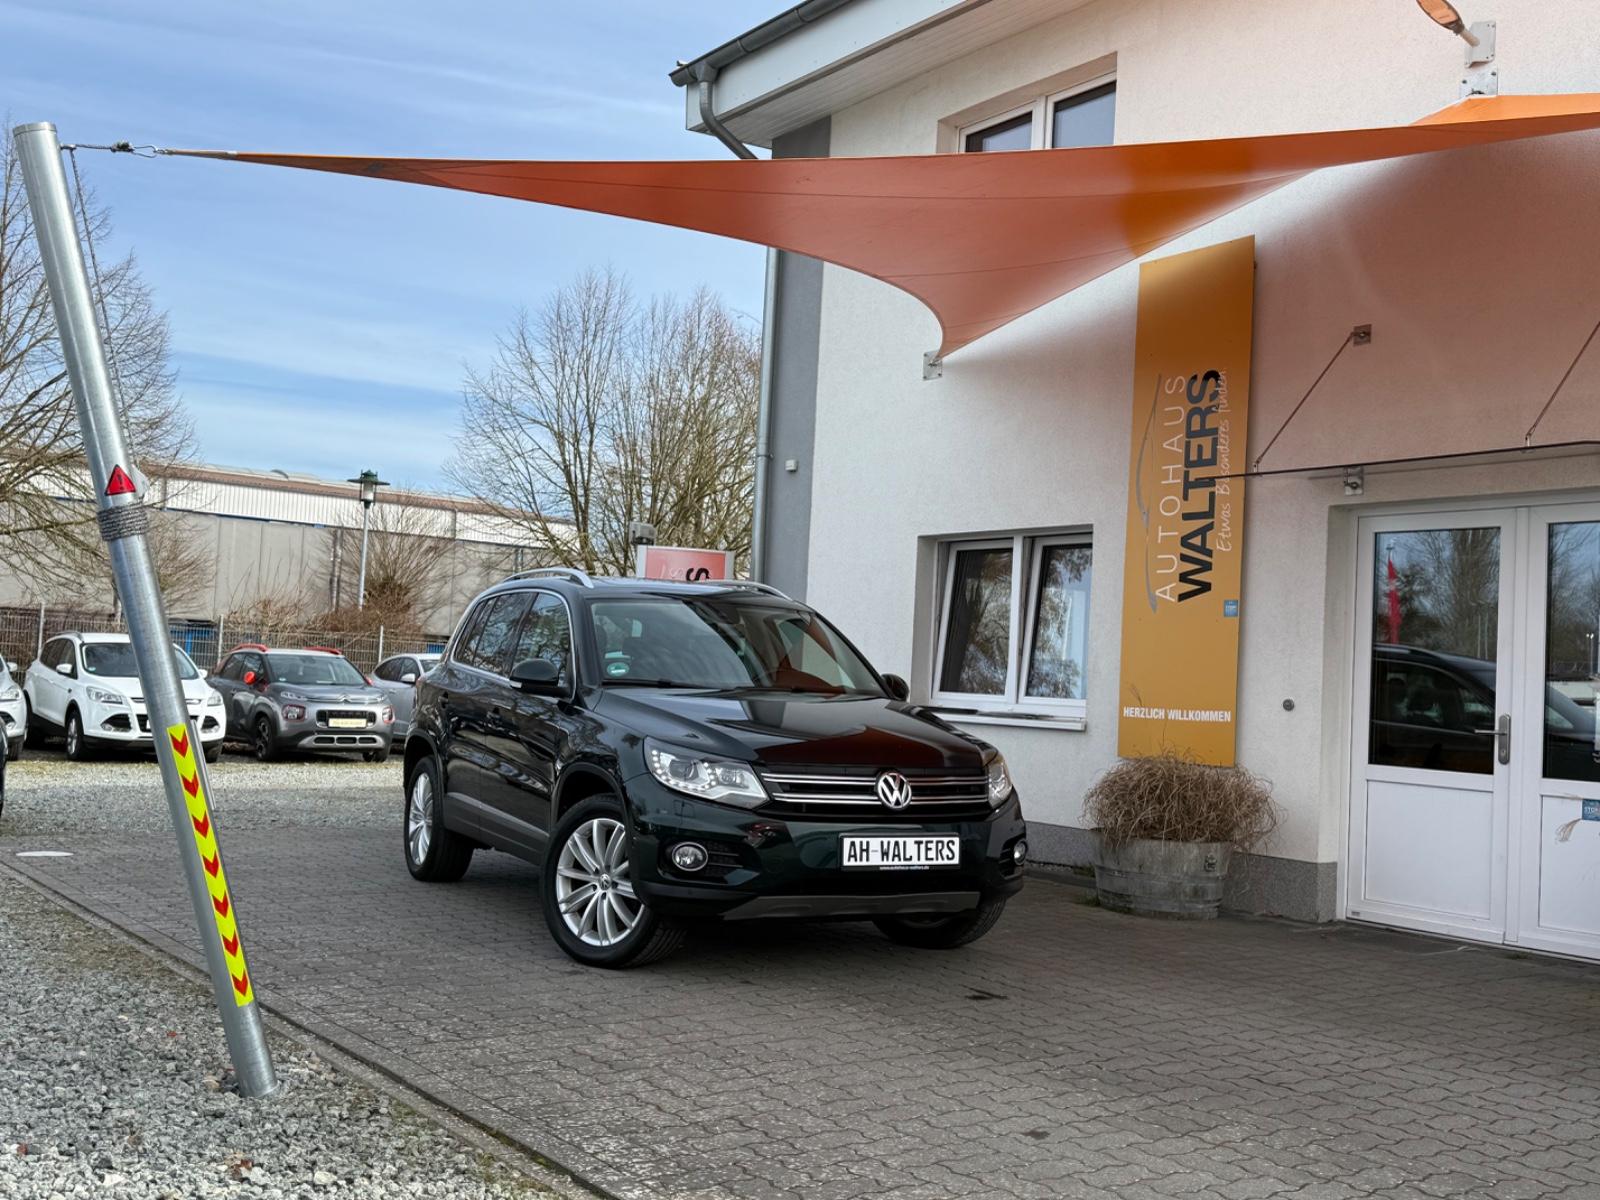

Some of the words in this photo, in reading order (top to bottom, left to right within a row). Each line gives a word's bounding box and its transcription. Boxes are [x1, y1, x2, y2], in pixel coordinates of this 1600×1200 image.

[1155, 376, 1186, 602] AUTOHAUS
[1177, 370, 1221, 602] WALTERS
[1216, 503, 1232, 552] Etwas
[1123, 706, 1165, 720] HERZLICH
[1167, 709, 1232, 722] WILLKOMMEN
